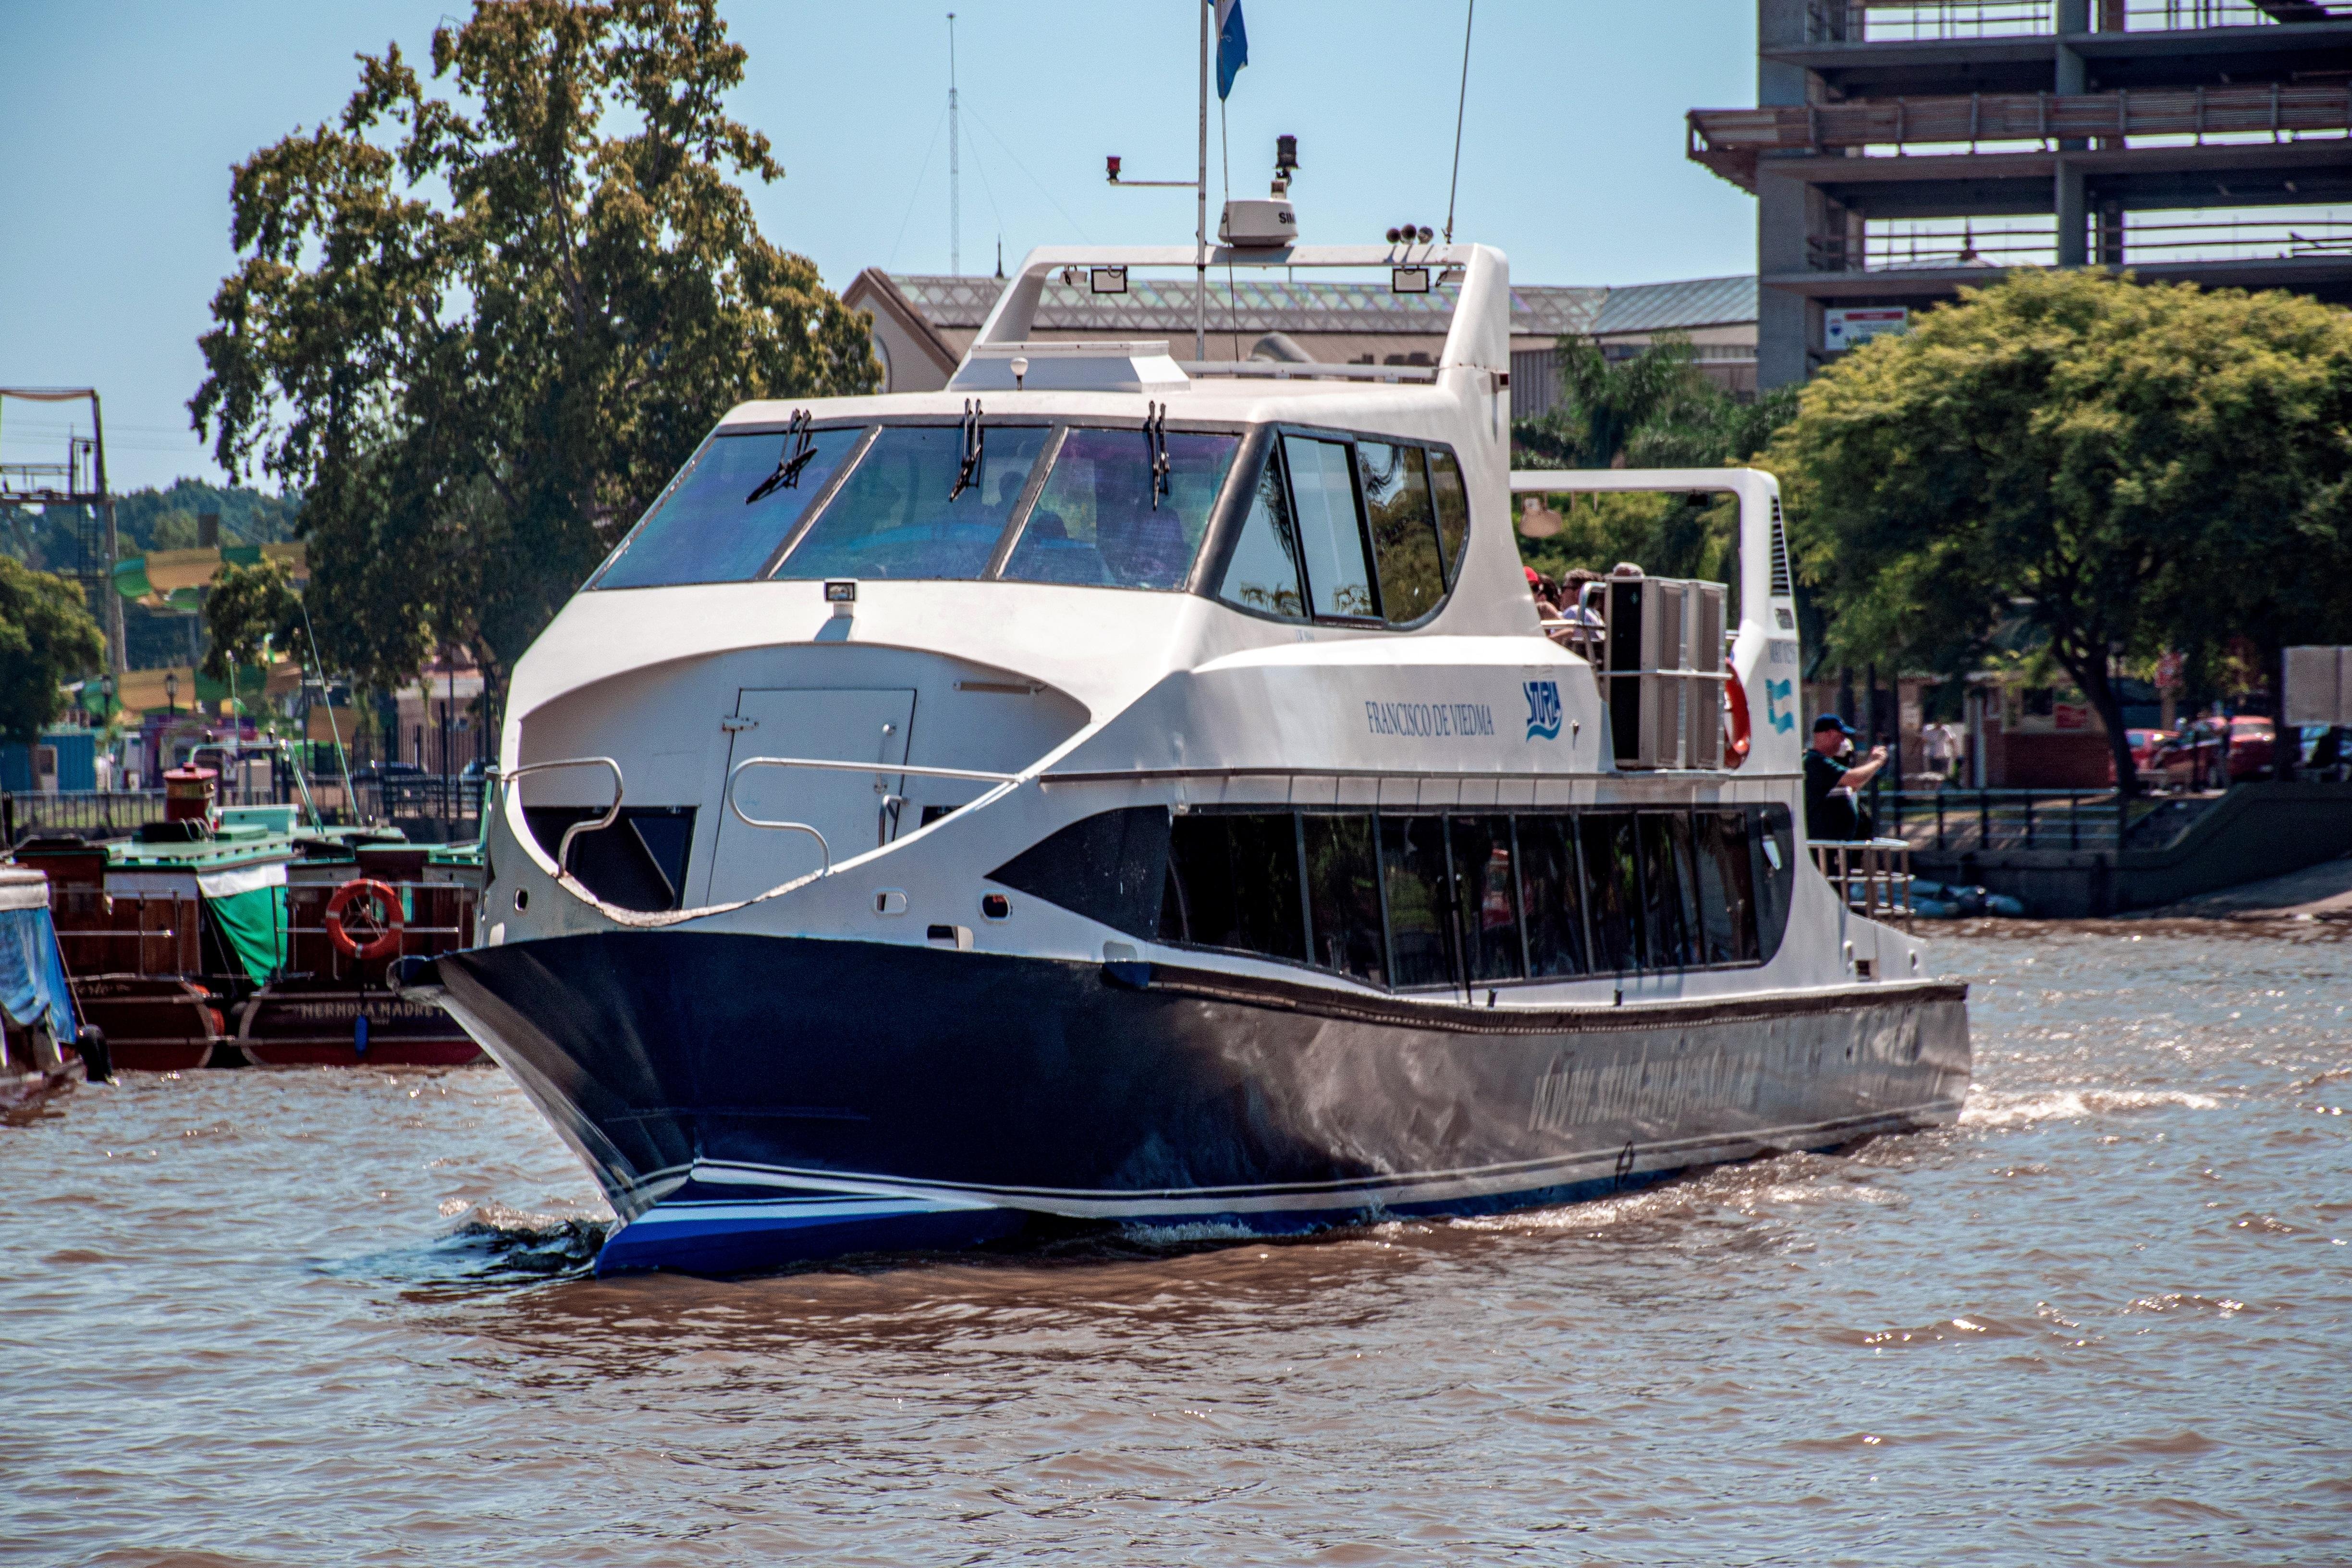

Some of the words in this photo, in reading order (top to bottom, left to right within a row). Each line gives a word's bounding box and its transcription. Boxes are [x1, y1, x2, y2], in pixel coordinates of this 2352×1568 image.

[1365, 700, 1431, 736] FRANCISCO
[1433, 704, 1450, 736] DE
[1450, 704, 1494, 736] VIEDMA
